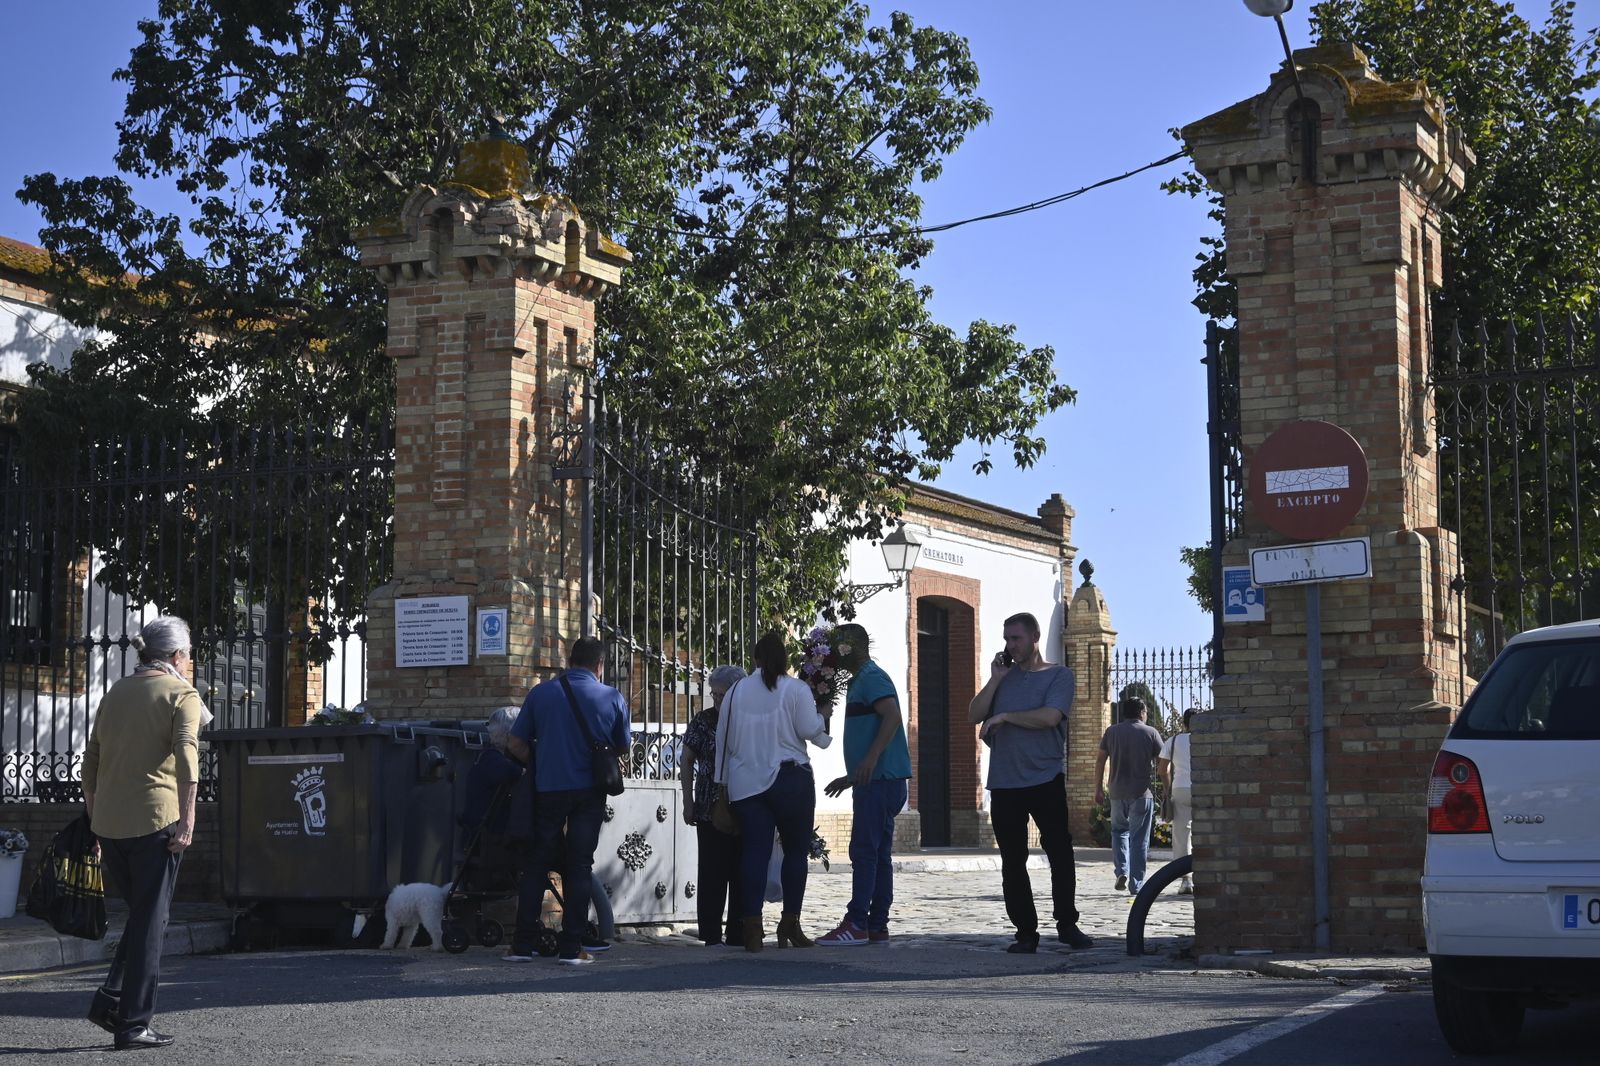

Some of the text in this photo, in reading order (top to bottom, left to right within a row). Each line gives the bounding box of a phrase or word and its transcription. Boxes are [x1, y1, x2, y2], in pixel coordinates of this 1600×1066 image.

[1277, 494, 1340, 508] EXCEPTO
[924, 547, 964, 564] CREMATORIO
[1503, 814, 1545, 824] POLO
[266, 822, 299, 830] Ayuntamiento
[1567, 915, 1575, 923] E
